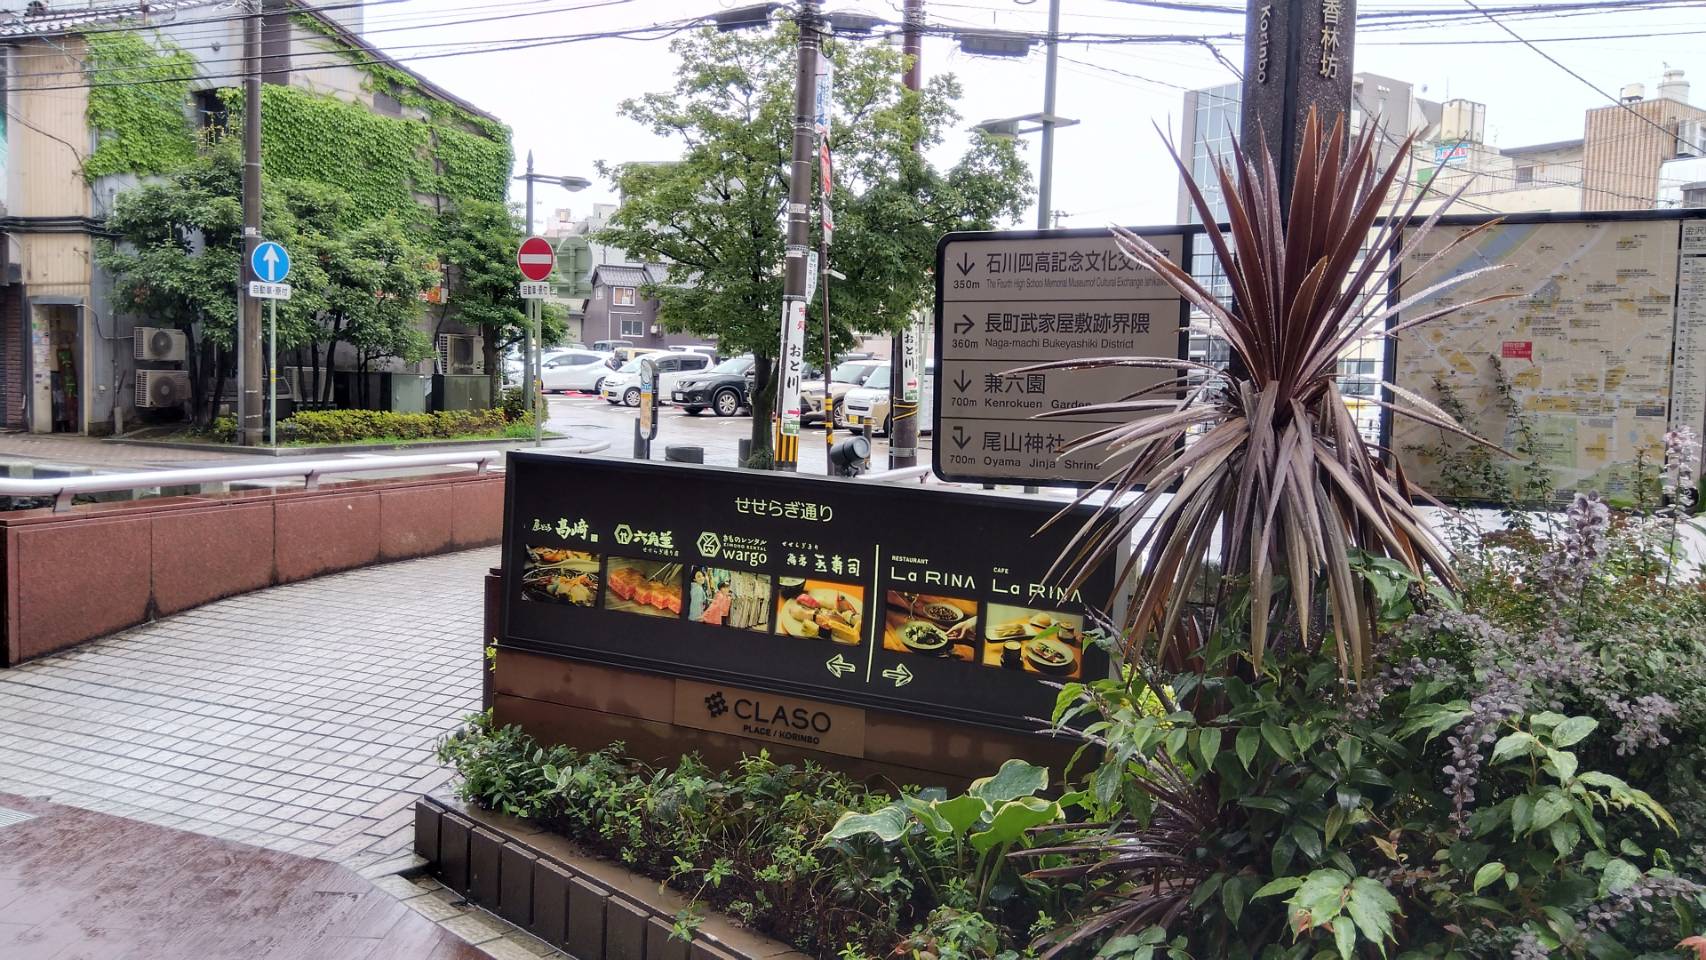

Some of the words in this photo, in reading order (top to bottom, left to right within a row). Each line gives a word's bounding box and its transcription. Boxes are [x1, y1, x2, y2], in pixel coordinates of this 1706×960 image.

[1258, 5, 1271, 83] Korinbo
[1320, 0, 1341, 79] 香林坊
[986, 249, 1170, 273] 石川四高記念文化交
[953, 279, 980, 289] 350m
[984, 313, 1150, 334] 長町武家屋敷跡界隈
[952, 339, 979, 349] 360m
[985, 338, 1039, 349] Naga-machi
[1042, 338, 1098, 349] Bukeyashiki
[1101, 338, 1134, 349] District
[984, 373, 1045, 394] 兼六園
[951, 397, 977, 407] 700m
[985, 398, 1042, 408] Kenrokuen
[982, 431, 1065, 454] 尾山神社
[950, 455, 976, 465] 700m
[984, 456, 1021, 467] Oyama
[1029, 458, 1056, 469] Jinja
[735, 497, 833, 522] せせらぎ通り
[633, 530, 674, 549] 六角堂
[723, 533, 767, 546] きものレンタル
[723, 549, 767, 566] wargo
[891, 555, 929, 565] RESTAURANT
[891, 566, 917, 582] La
[925, 570, 976, 590] RINA
[992, 579, 1020, 595] La
[734, 698, 831, 733] CLASO
[743, 724, 772, 737] PLACE
[779, 730, 820, 744] KORINBO
